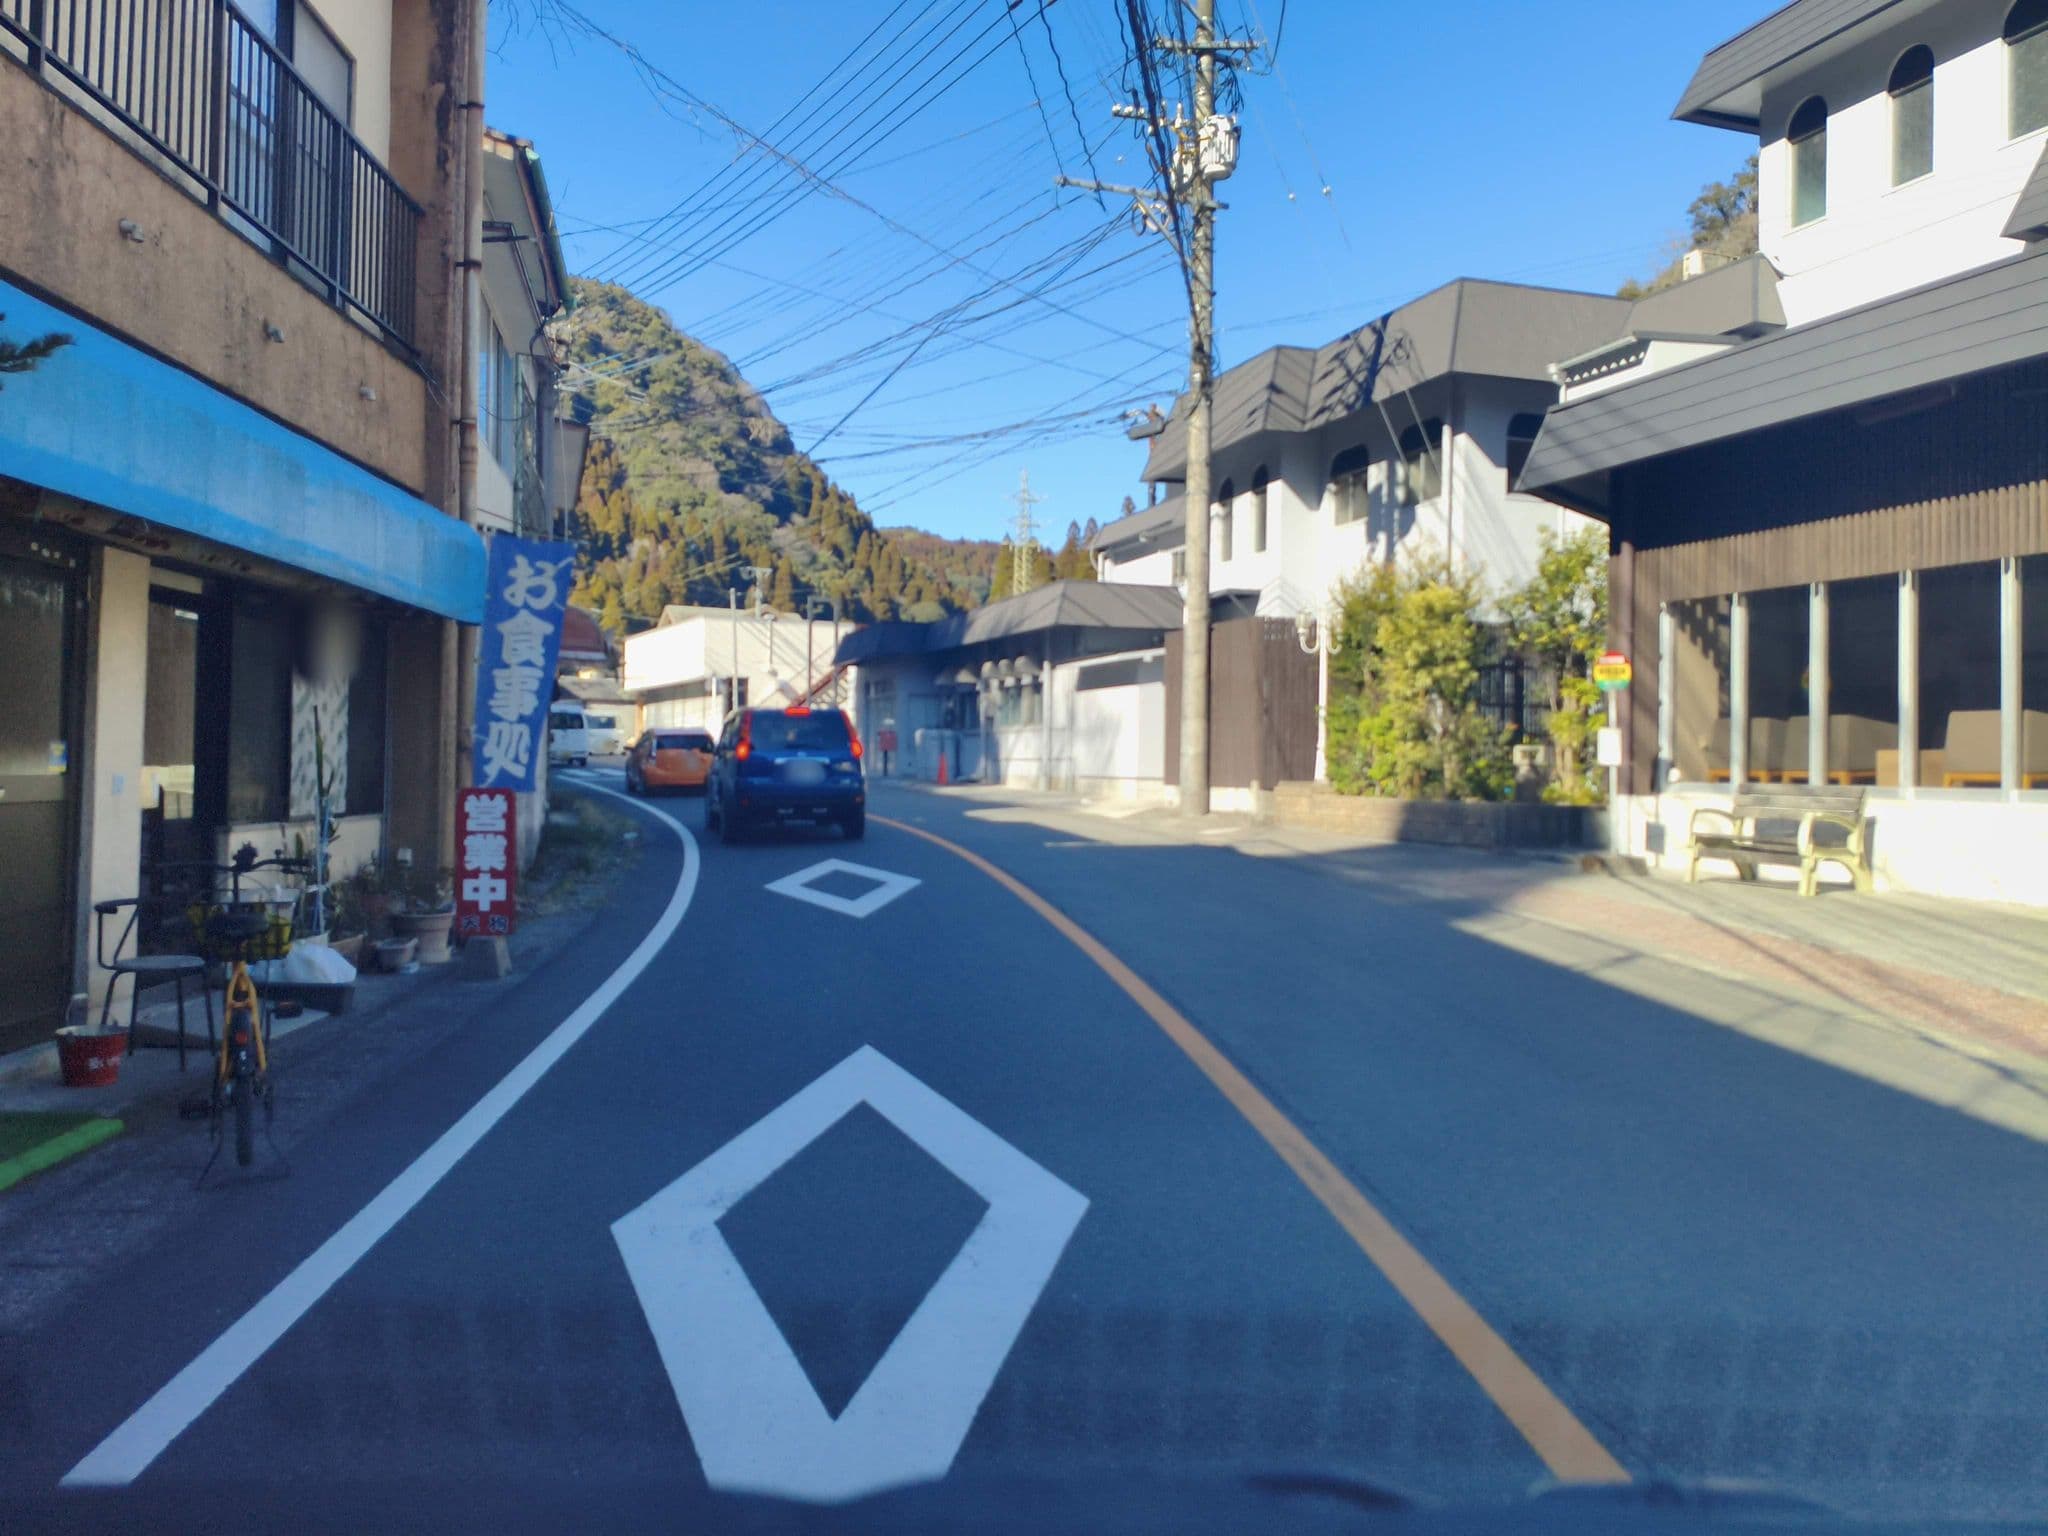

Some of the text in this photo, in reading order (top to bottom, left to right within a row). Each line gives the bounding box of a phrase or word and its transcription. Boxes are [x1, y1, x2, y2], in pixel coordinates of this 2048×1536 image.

[482, 554, 566, 787] お食事処
[463, 793, 508, 912] 営業中
